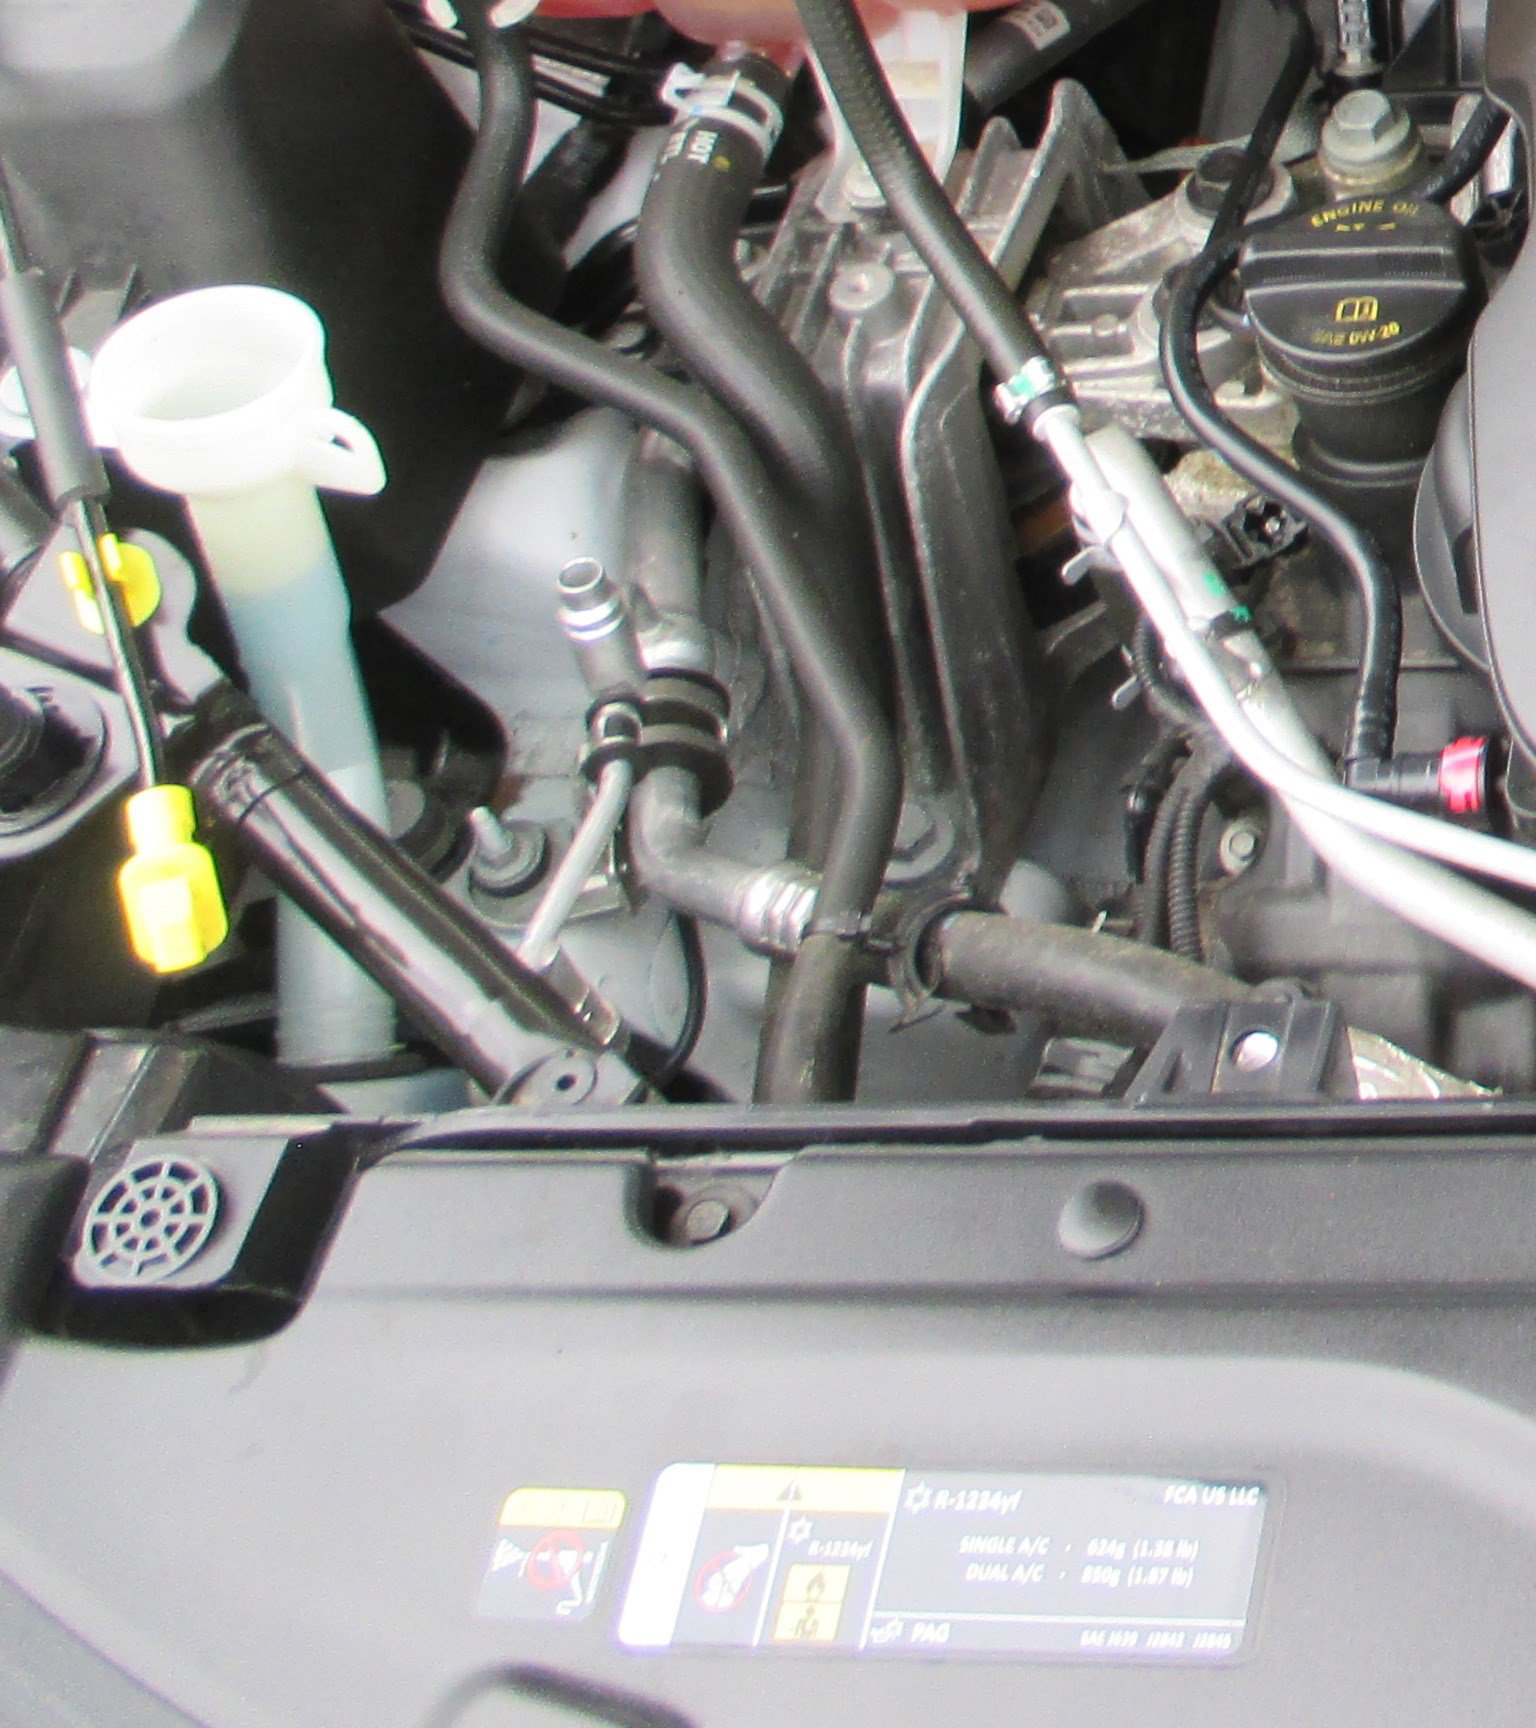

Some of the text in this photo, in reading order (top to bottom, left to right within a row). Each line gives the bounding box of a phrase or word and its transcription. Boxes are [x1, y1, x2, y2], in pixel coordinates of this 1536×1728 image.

[1311, 200, 1384, 227] ENGINE
[934, 1488, 1024, 1516] R-1234yf
[1163, 1484, 1261, 1507] FCA US LLC
[958, 1534, 1016, 1555] SINGLE
[1017, 1535, 1051, 1557] A/C
[965, 1563, 1010, 1583] DUAL
[1011, 1564, 1045, 1584] A/C
[909, 1621, 951, 1645] PAG
